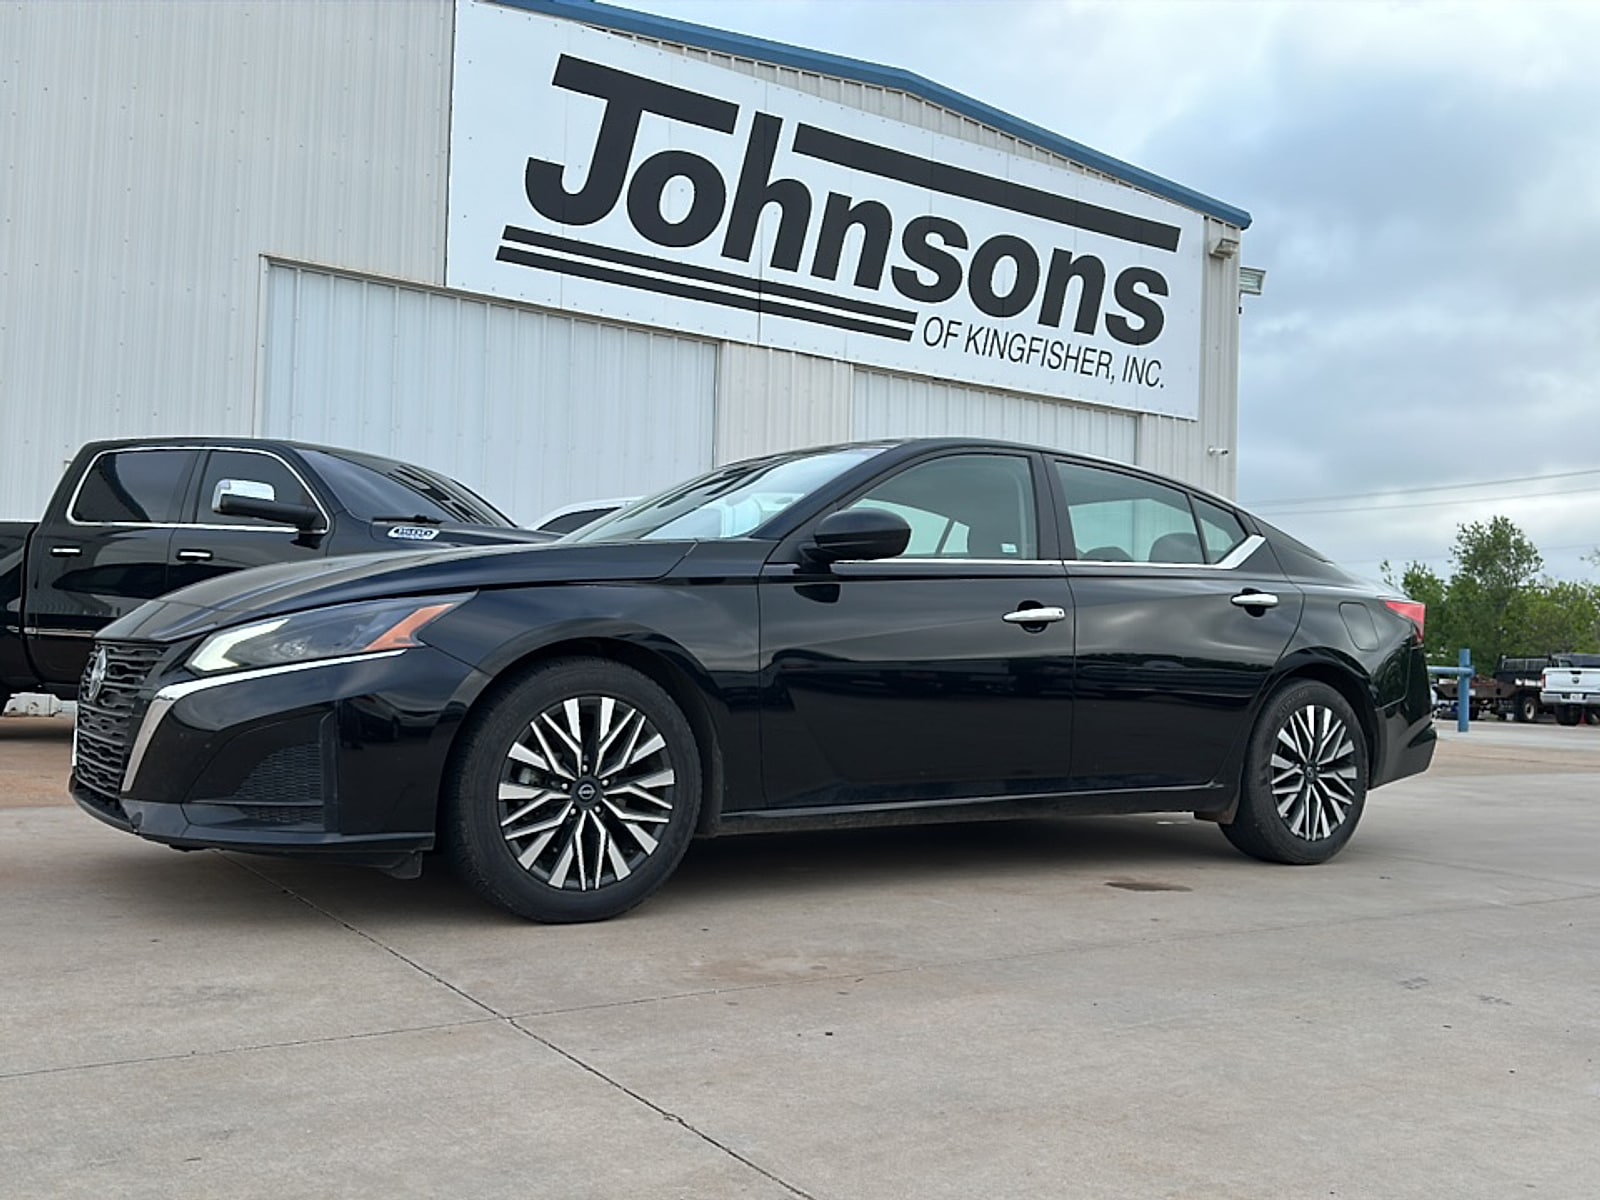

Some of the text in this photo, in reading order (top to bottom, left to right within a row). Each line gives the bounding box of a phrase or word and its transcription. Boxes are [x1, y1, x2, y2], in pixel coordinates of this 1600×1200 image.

[525, 54, 1169, 346] Johnsons
[923, 316, 1165, 389] OF KINGFISHER, INC.
